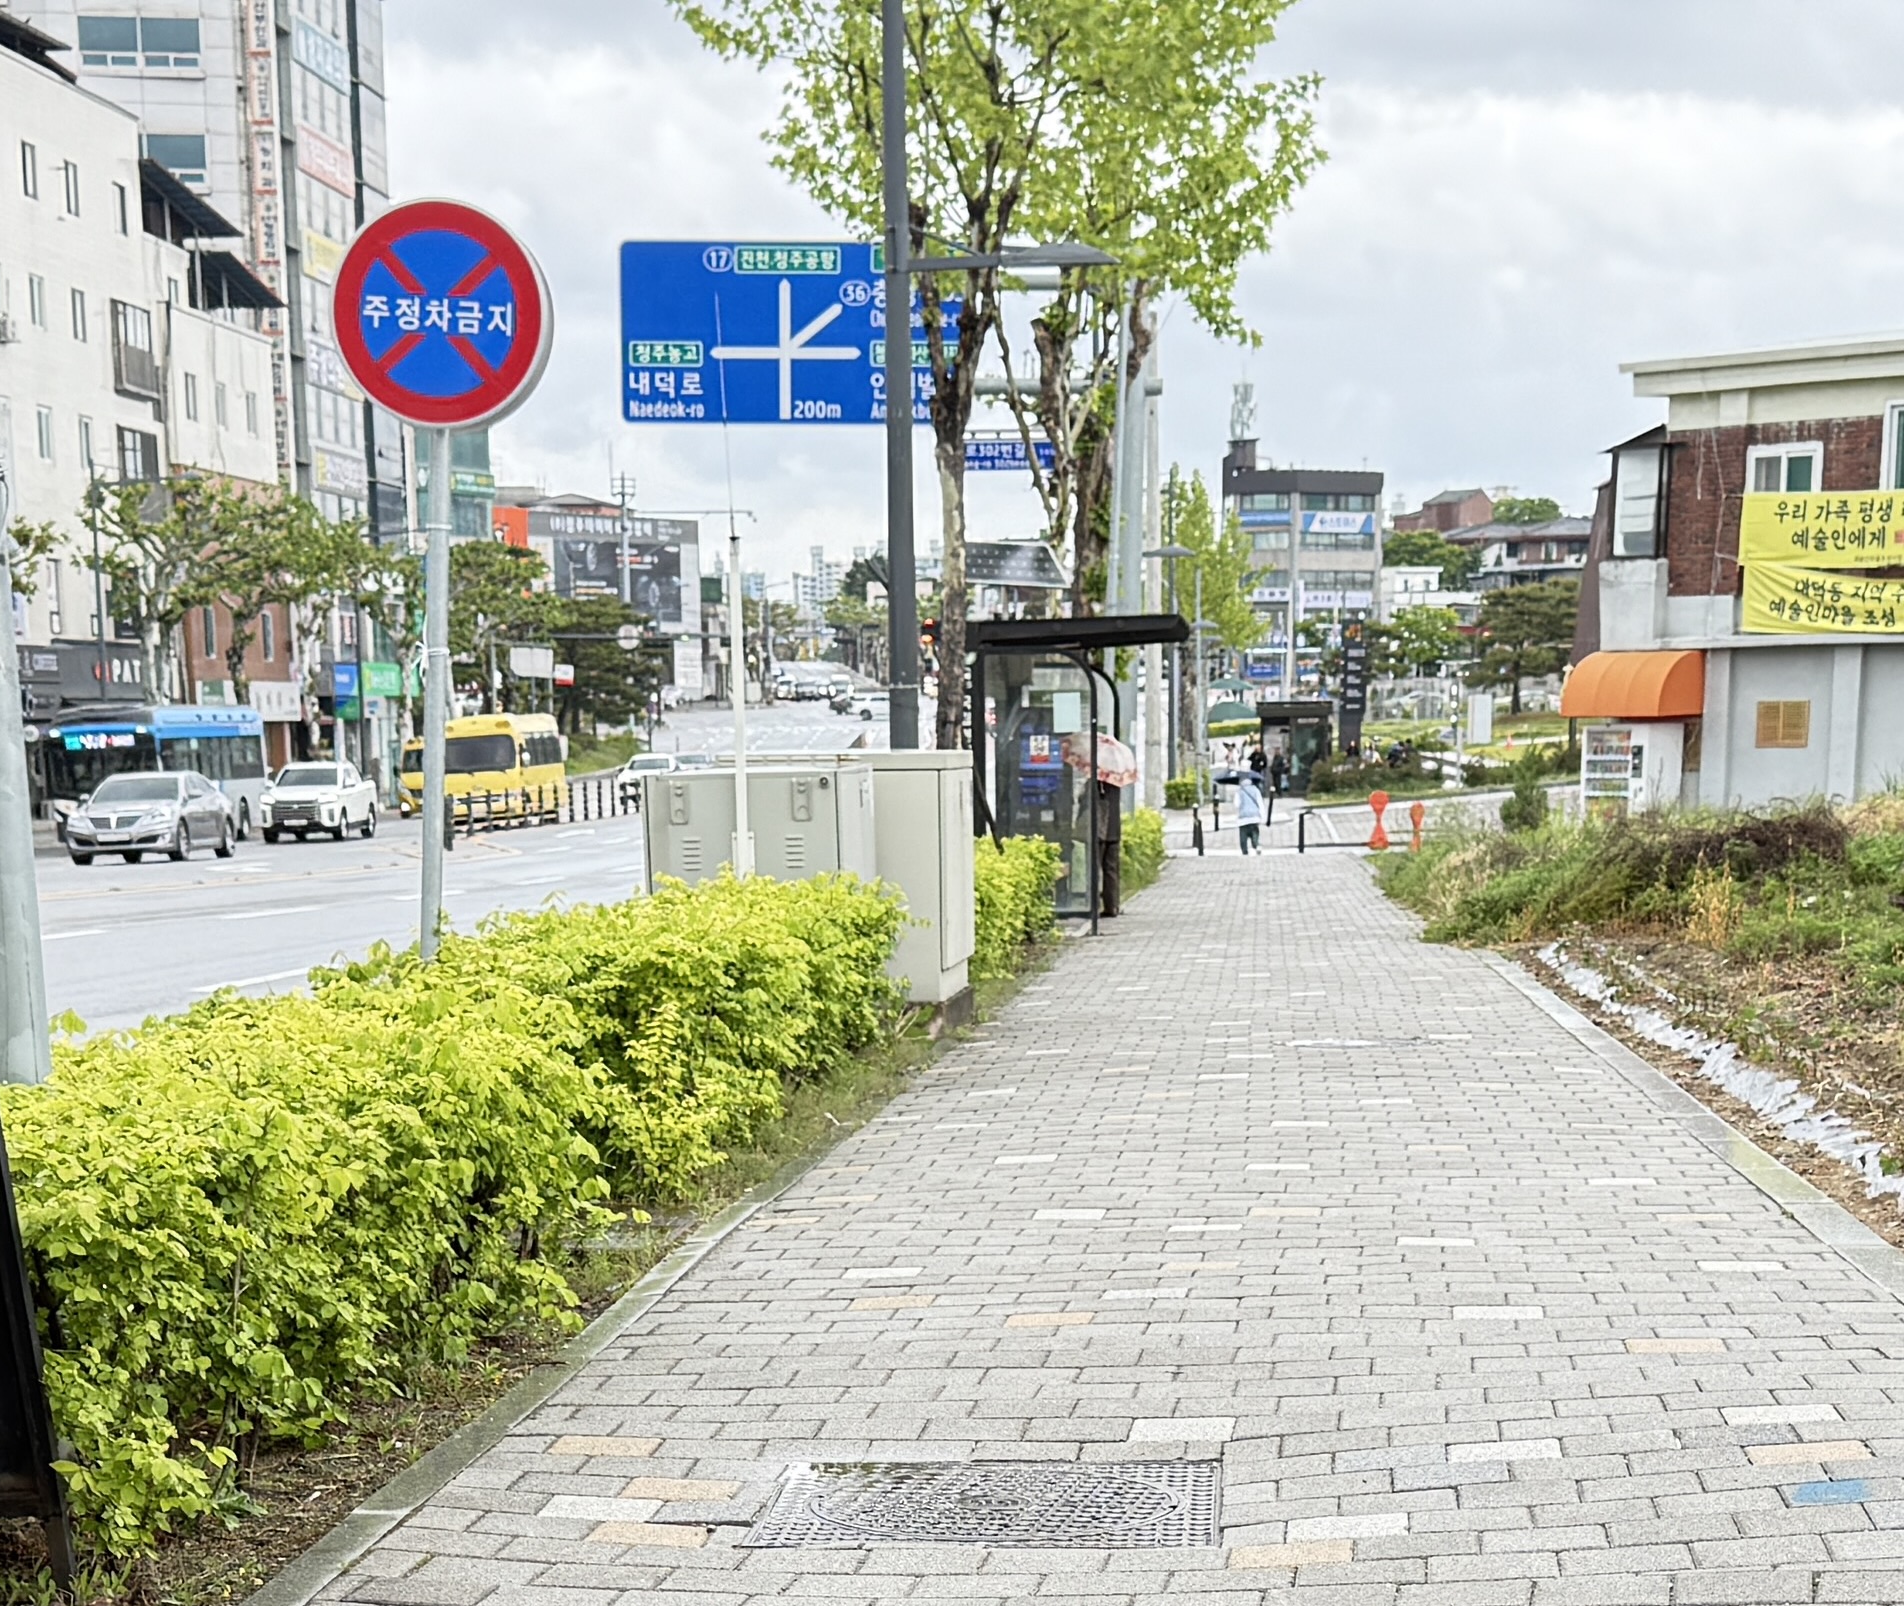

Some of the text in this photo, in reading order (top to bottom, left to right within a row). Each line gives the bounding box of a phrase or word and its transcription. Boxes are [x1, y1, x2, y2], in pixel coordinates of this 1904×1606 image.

[708, 250, 728, 270] 17
[846, 285, 866, 302] 36
[362, 294, 514, 338] 주정차금지
[635, 344, 698, 364] 청주농고
[628, 371, 704, 399] 내덕로
[629, 401, 705, 418] Naedeok-ro
[793, 401, 842, 419] 200m
[1774, 500, 1807, 524] 우리
[1815, 499, 1851, 524] 가족
[1858, 497, 1893, 524] 평생
[1791, 526, 1886, 551] 예술인에게
[1851, 581, 1886, 603] 지역
[1769, 597, 1856, 626] 예술인마을
[1863, 606, 1896, 627] 조성
